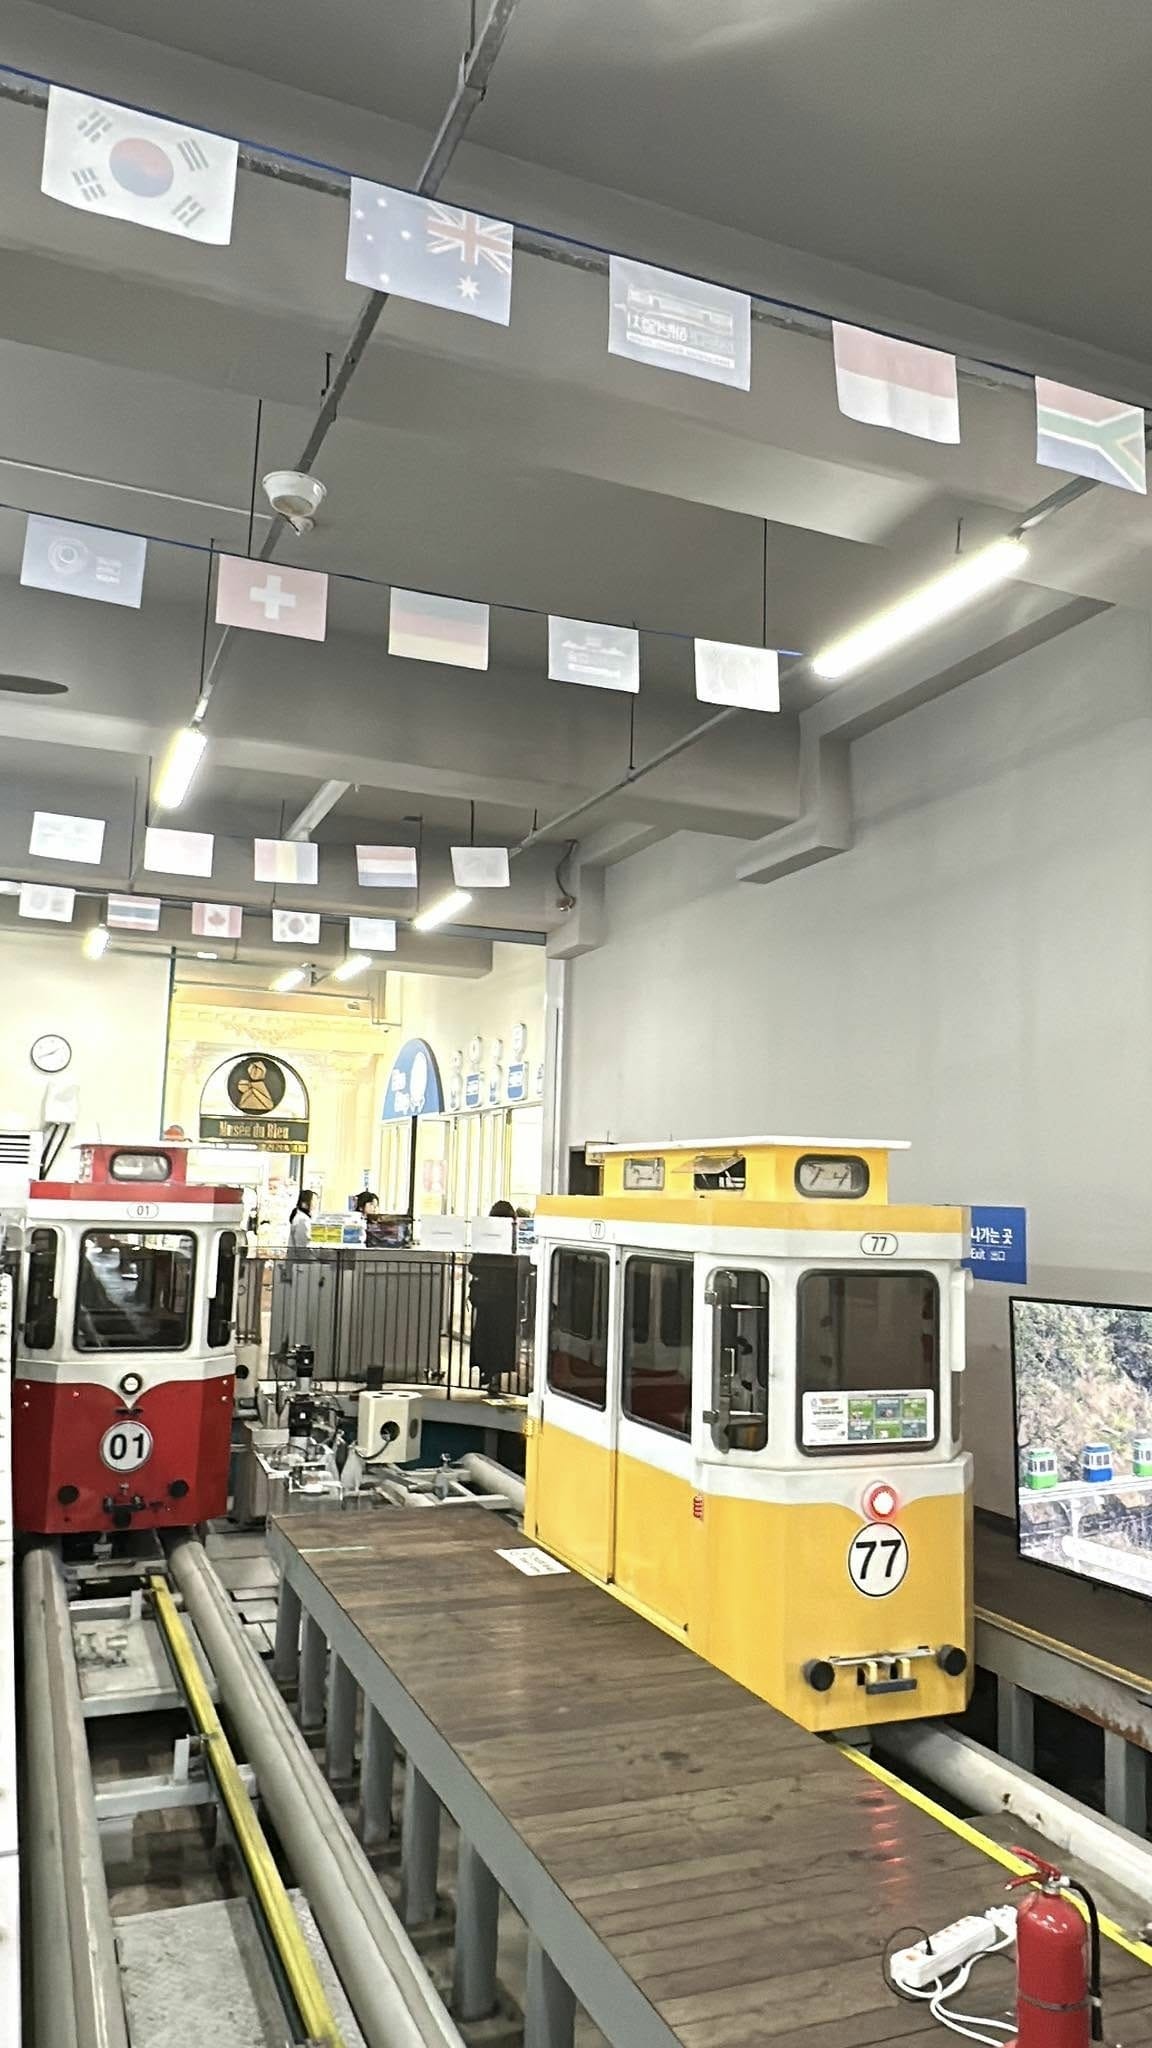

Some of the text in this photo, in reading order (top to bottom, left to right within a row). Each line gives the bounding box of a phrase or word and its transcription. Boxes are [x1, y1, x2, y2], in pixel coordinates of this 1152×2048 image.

[137, 1205, 150, 1216] 01
[871, 1236, 888, 1252] 77
[970, 1226, 1014, 1245] 나가는 곳
[970, 1247, 986, 1261] Exit
[110, 1433, 144, 1460] 01
[855, 1539, 902, 1580] 77
